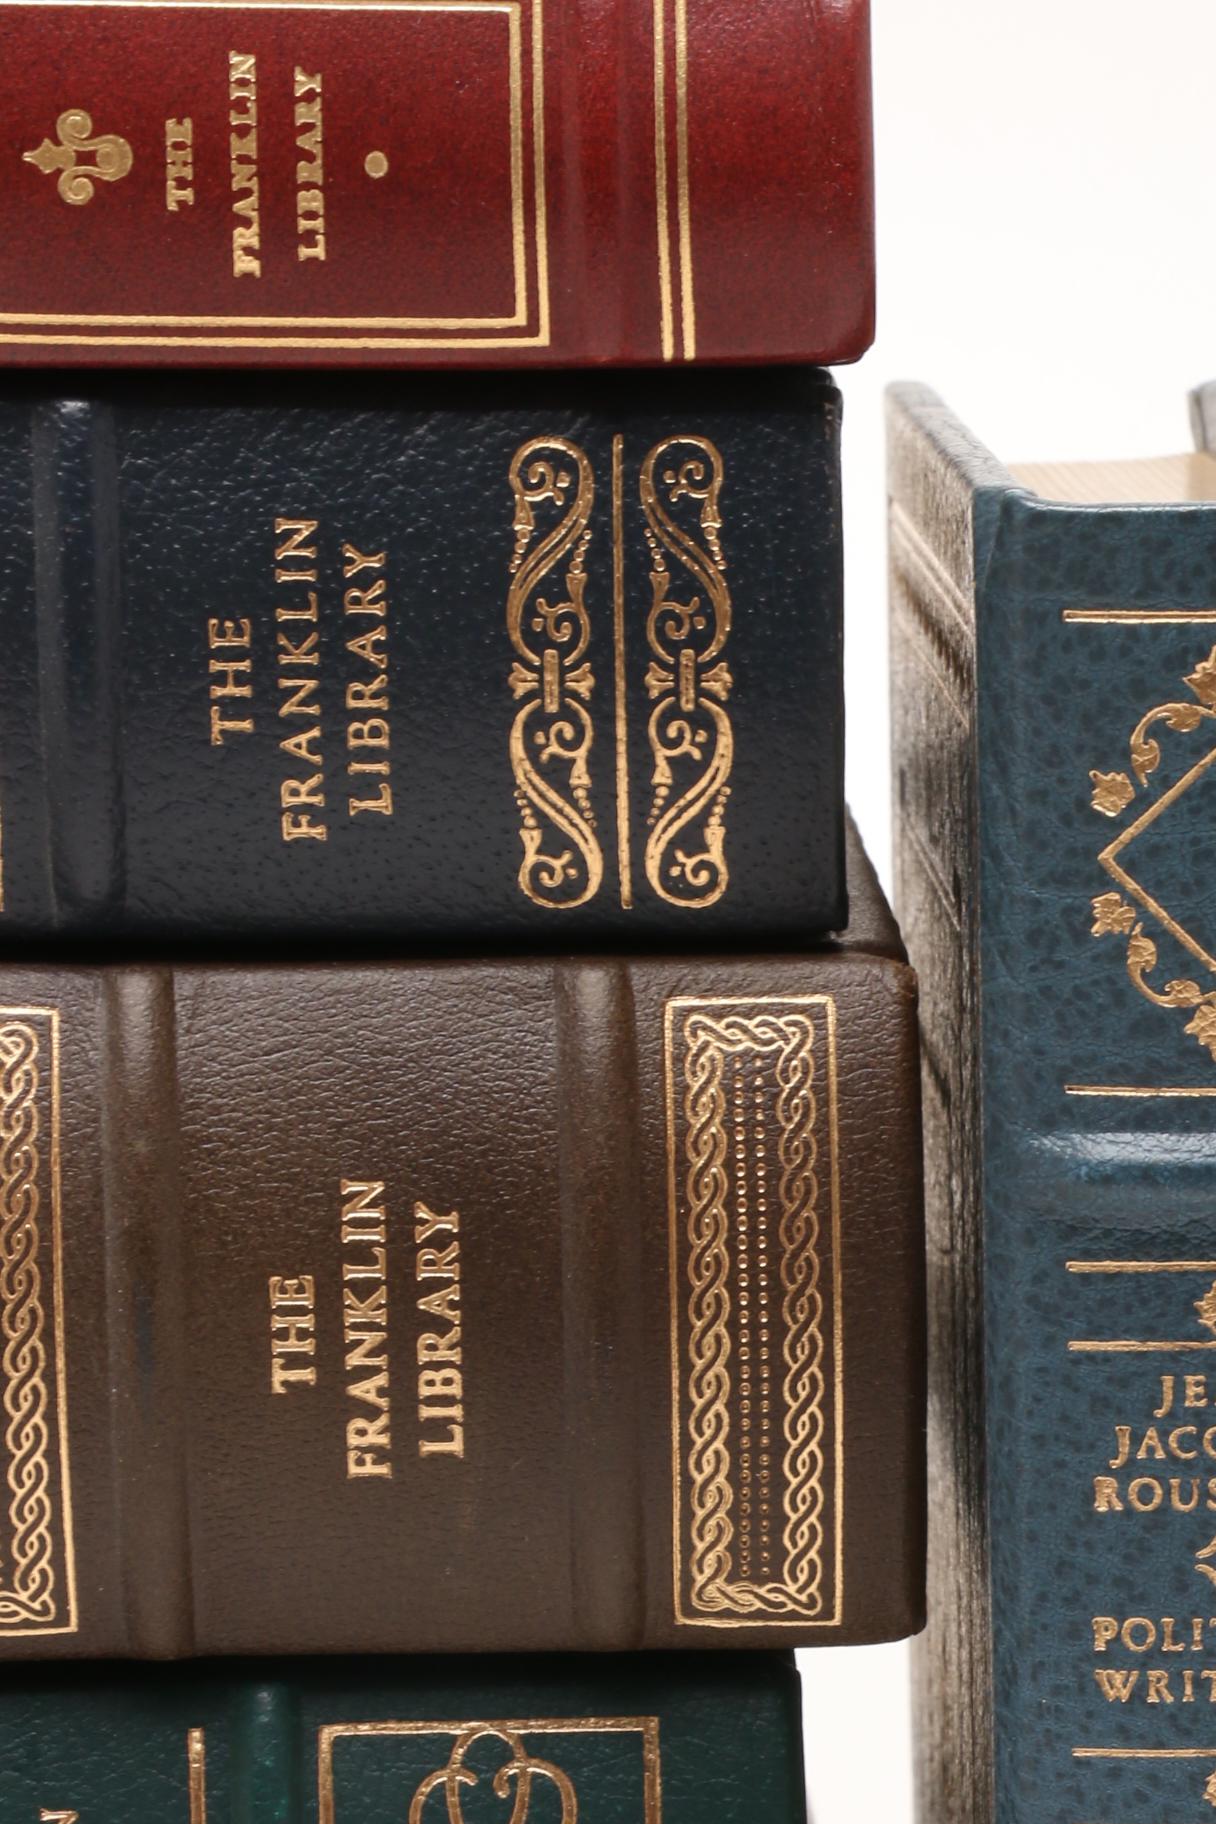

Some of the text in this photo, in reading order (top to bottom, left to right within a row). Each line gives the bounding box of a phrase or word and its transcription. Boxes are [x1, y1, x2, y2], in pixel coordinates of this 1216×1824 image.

[164, 117, 195, 212] THE
[228, 50, 262, 278] FRANKLIN
[293, 65, 327, 262] LIBRARY
[208, 618, 254, 746] THE
[274, 517, 328, 842] FRANKLIN
[342, 543, 394, 817] LIBRARY
[268, 1274, 317, 1394] THE
[340, 1178, 393, 1479] FRANKLIN
[414, 1201, 465, 1459] LIBRARY
